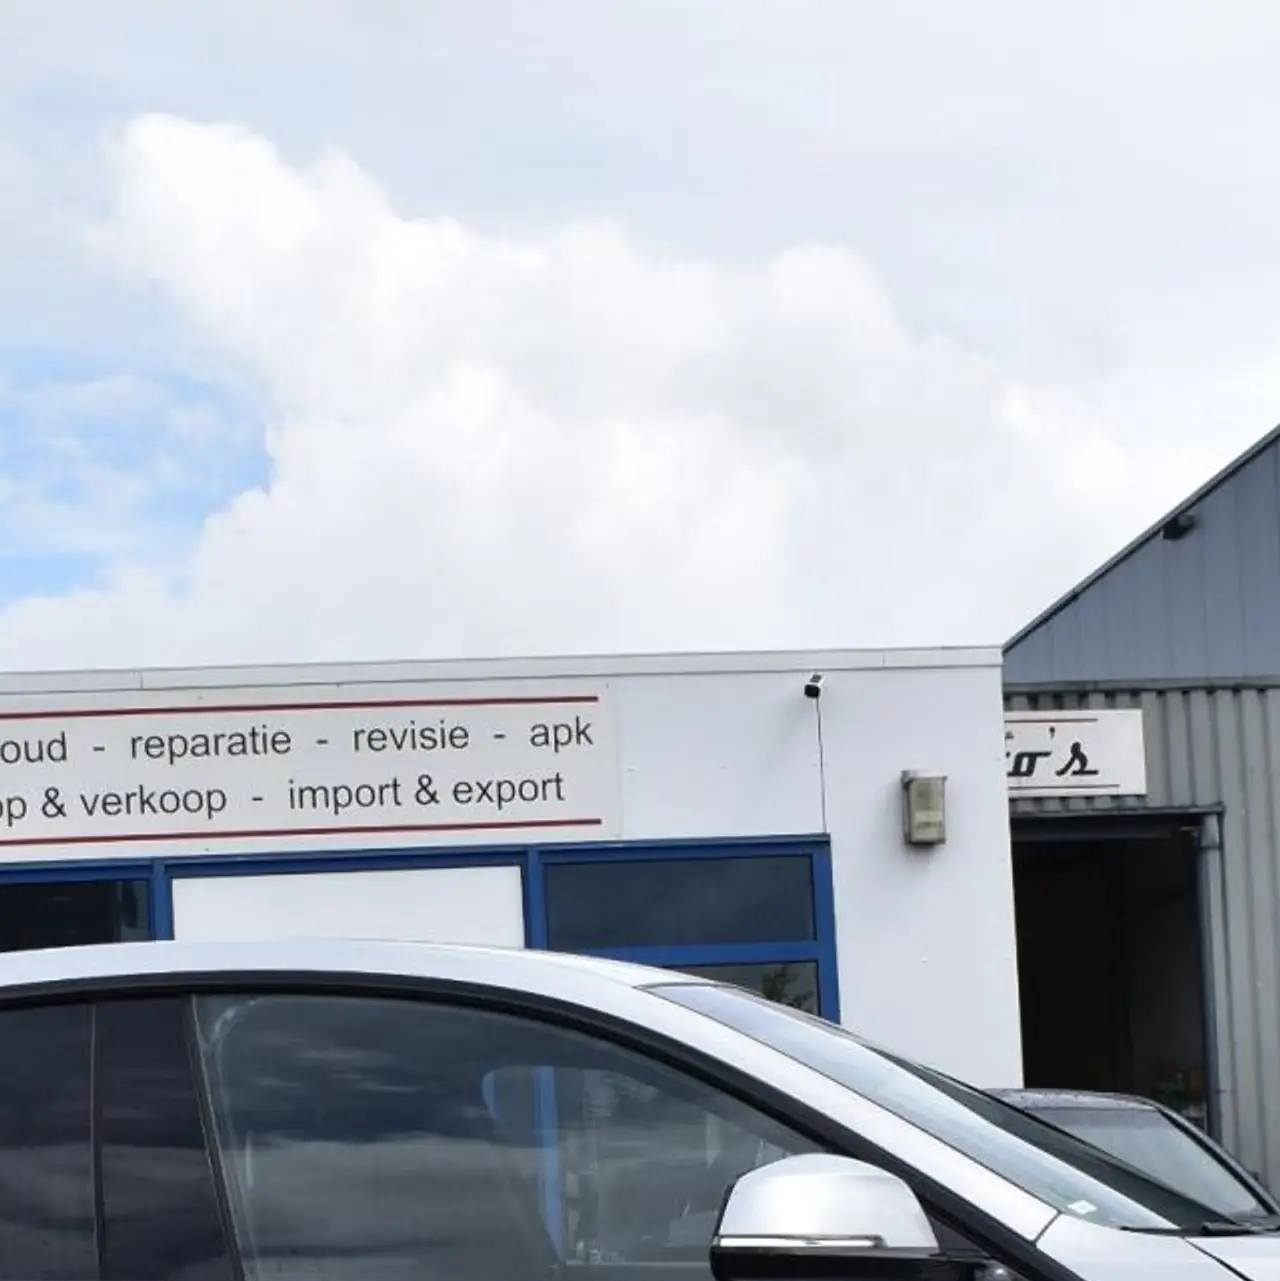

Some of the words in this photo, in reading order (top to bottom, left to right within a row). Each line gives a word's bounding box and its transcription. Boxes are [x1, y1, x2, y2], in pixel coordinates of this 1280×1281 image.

[131, 725, 292, 766] reparatie
[353, 719, 470, 752] revisie
[529, 715, 593, 754] apk
[41, 786, 67, 818] &
[79, 784, 227, 820] verkoop
[289, 777, 402, 812] import
[414, 774, 440, 806] &
[452, 772, 565, 812] export
